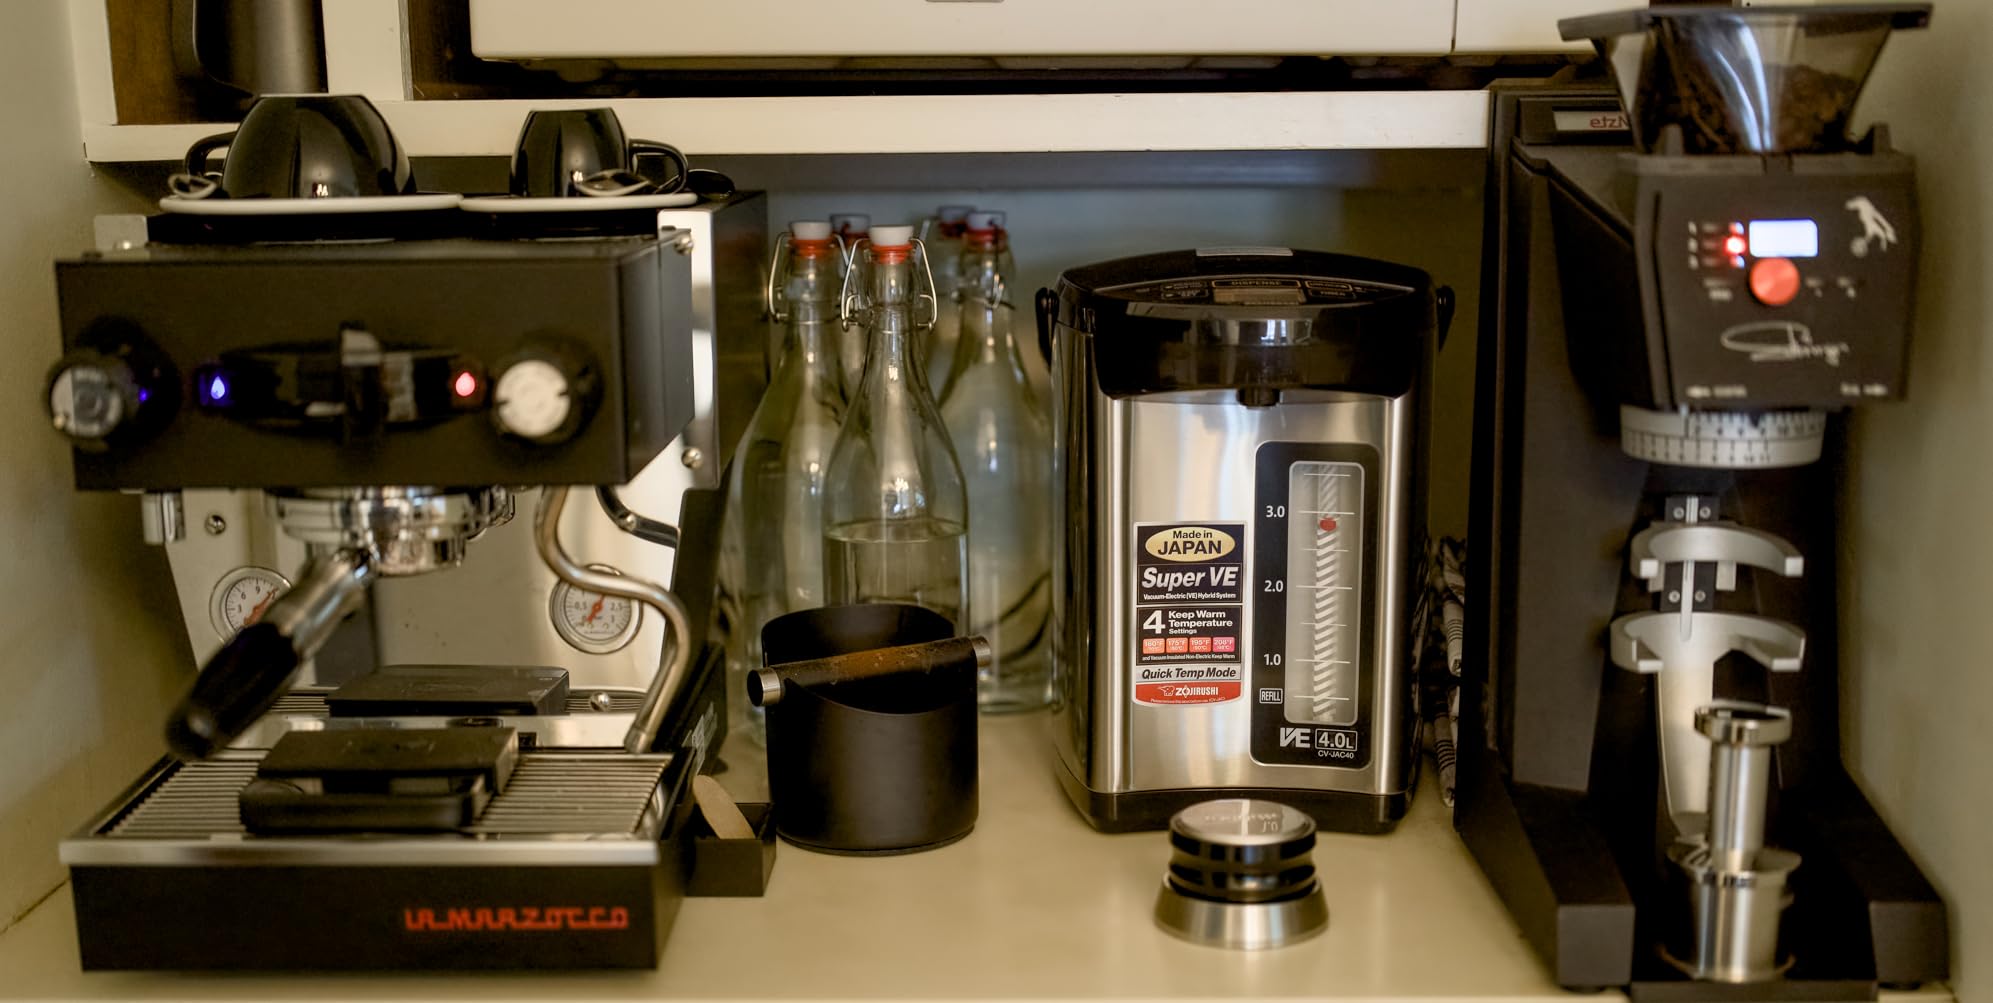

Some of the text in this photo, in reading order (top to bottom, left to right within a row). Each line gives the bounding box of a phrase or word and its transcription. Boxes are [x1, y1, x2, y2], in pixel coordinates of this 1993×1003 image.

[1265, 505, 1286, 518] 3.0
[1173, 530, 1213, 539] Made in
[1157, 540, 1222, 555] JAPAN
[1141, 566, 1239, 592] Super VE
[1264, 579, 1284, 593] 2.0
[1168, 610, 1226, 619] Keep Warm
[1142, 610, 1166, 634] 4
[1168, 620, 1233, 628] Temperature
[1263, 653, 1281, 666] 1.0
[1141, 667, 1236, 679] Quick Temp Mode
[1175, 685, 1219, 698] ZOJIRUSHI
[1261, 691, 1280, 701] REFILL
[1280, 727, 1311, 748] VE
[1318, 731, 1354, 749] 4.0L
[1317, 750, 1354, 758] CV-JAC40
